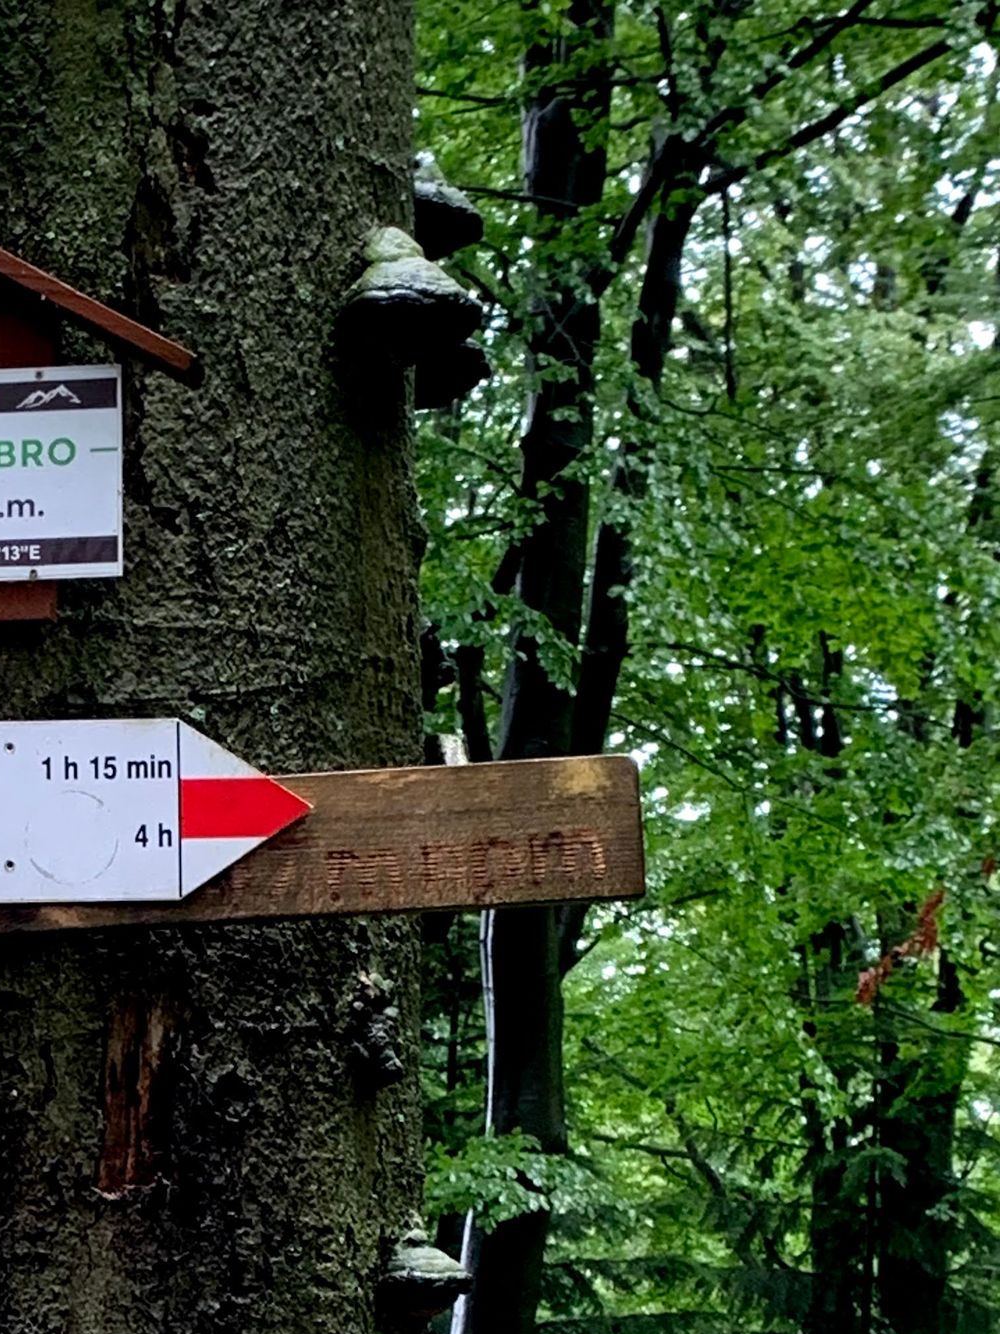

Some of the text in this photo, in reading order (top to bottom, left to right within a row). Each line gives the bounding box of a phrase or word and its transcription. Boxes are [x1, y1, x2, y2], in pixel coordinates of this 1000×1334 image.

[42, 757, 51, 780] 1
[65, 757, 78, 780] h
[91, 757, 117, 779] 15
[127, 757, 171, 779] min
[135, 825, 148, 847] 4
[159, 824, 172, 847] h
